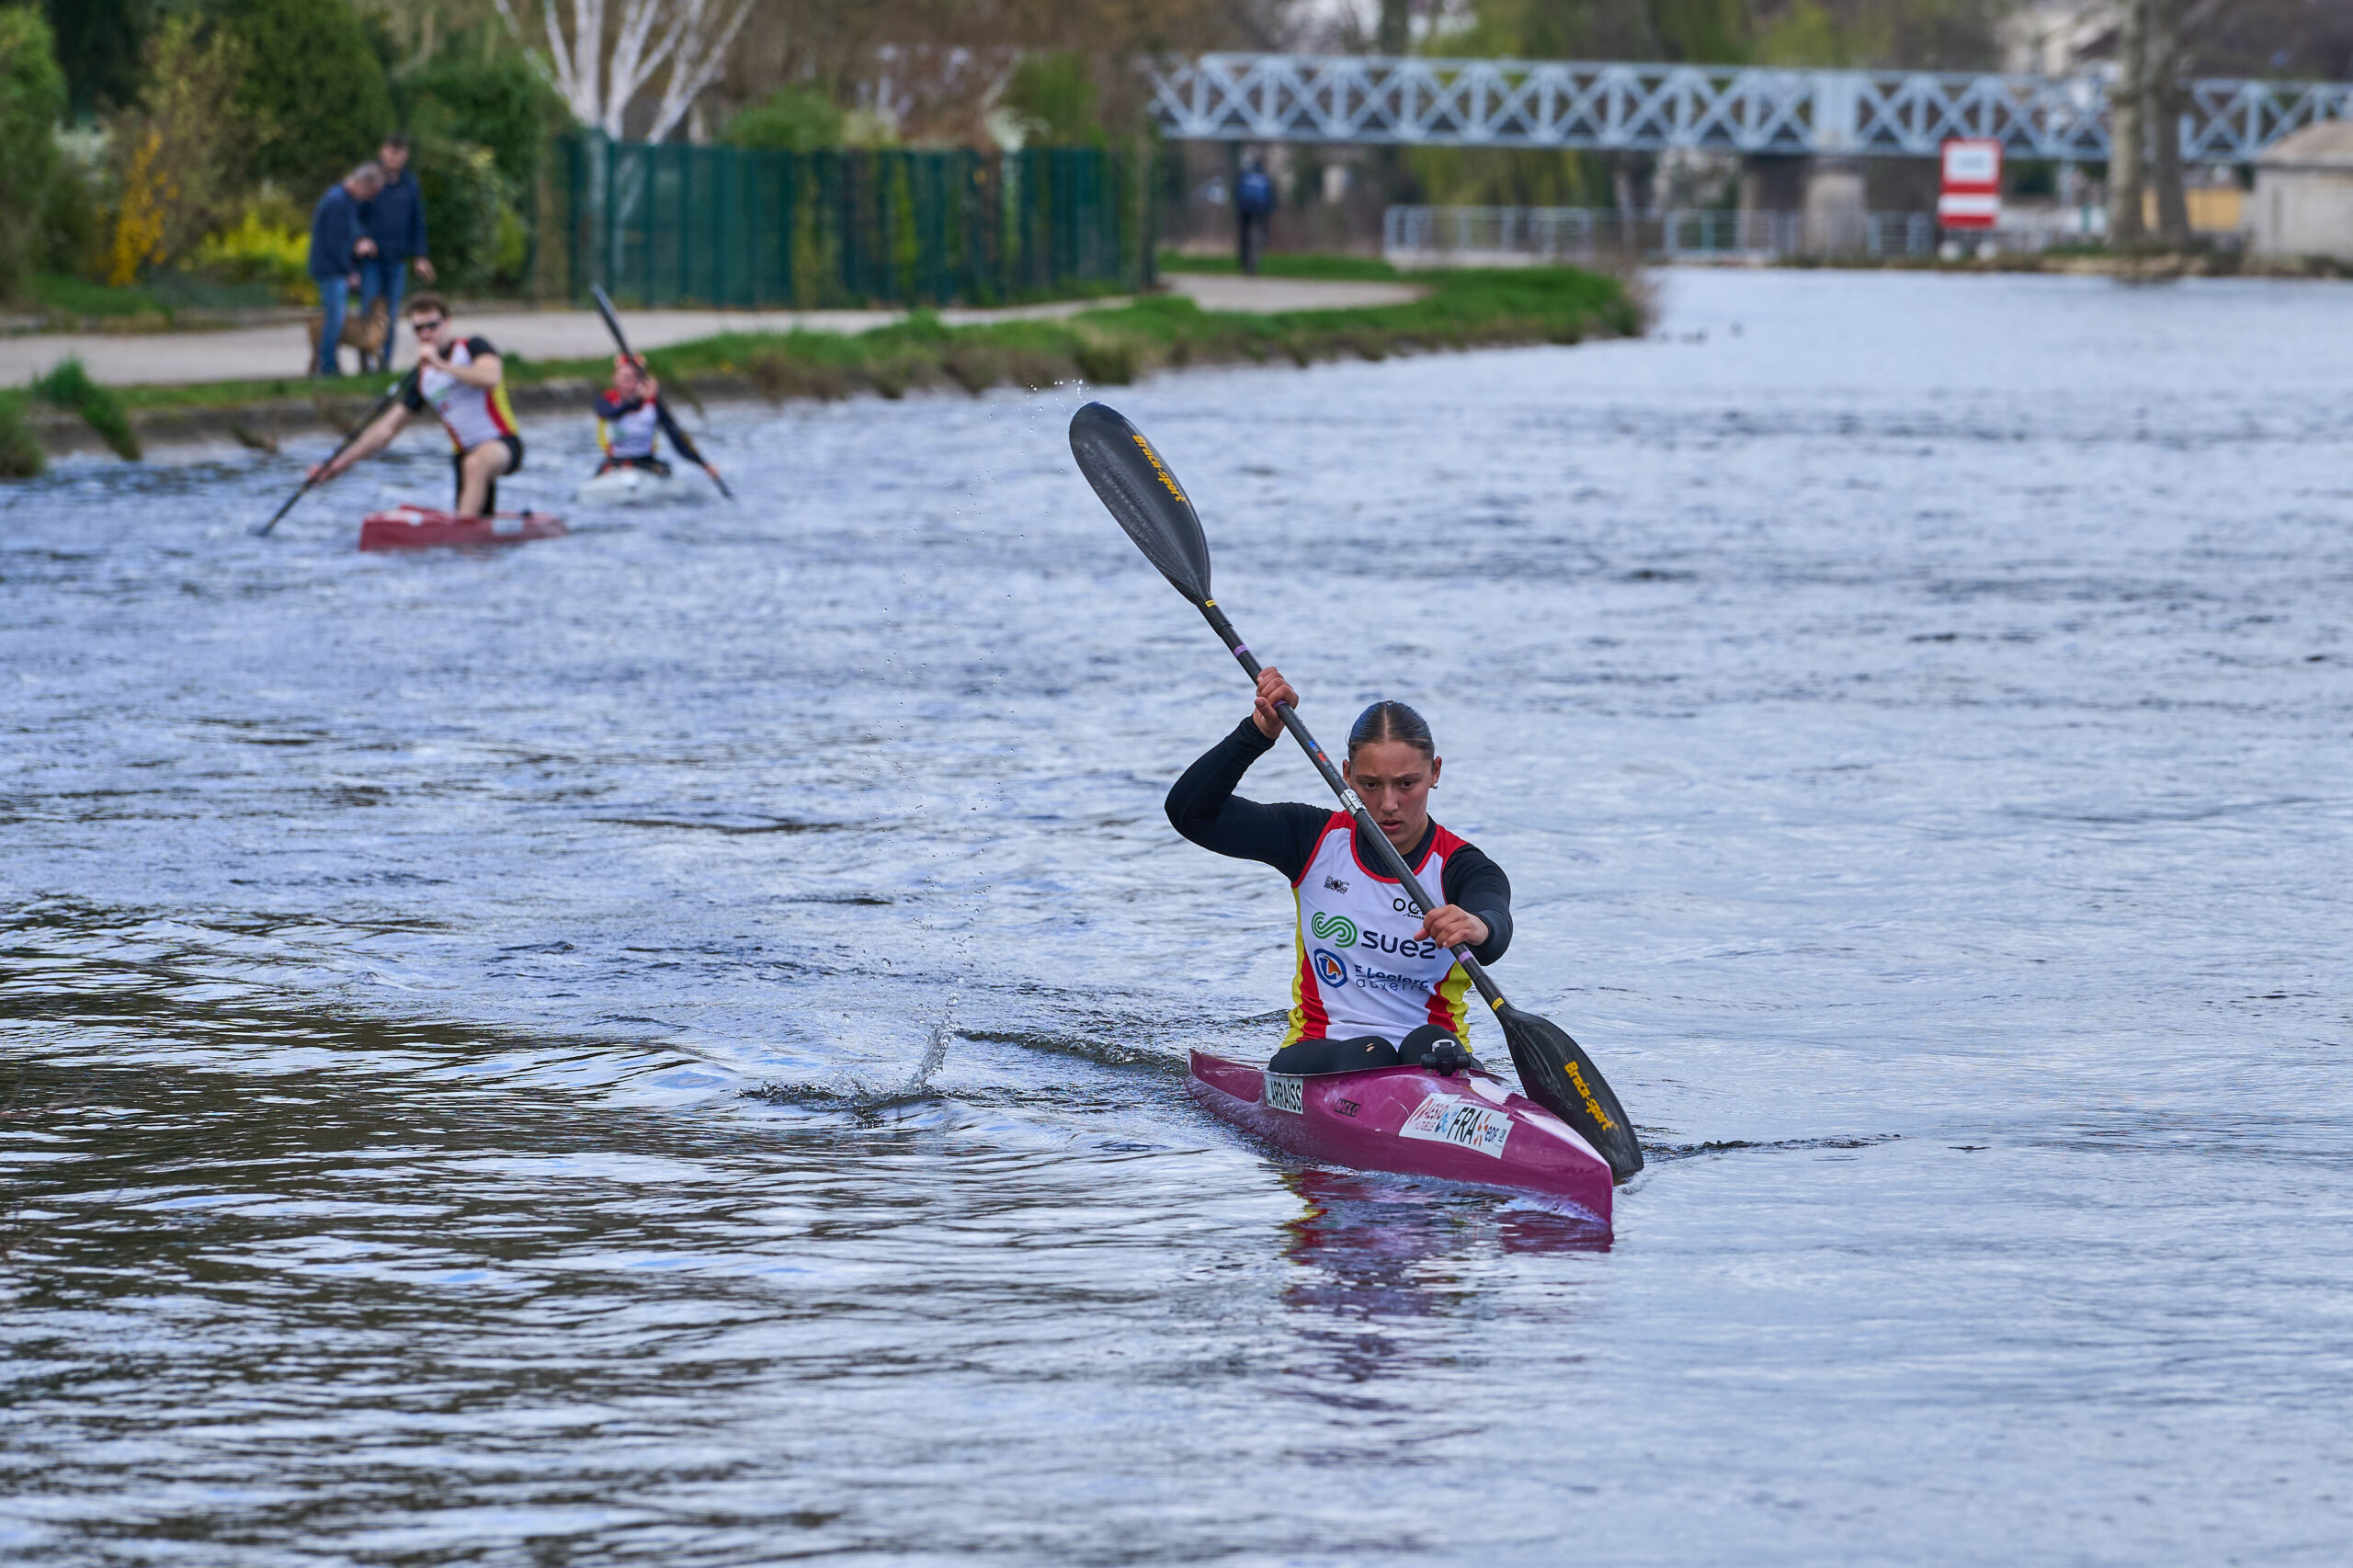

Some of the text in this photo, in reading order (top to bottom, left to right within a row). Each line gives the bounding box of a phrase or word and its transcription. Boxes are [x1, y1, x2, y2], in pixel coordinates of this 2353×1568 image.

[1392, 897, 1427, 916] OC
[1360, 929, 1438, 960] suez
[1336, 1099, 1360, 1116] NELO
[1446, 1107, 1483, 1145] FRA
